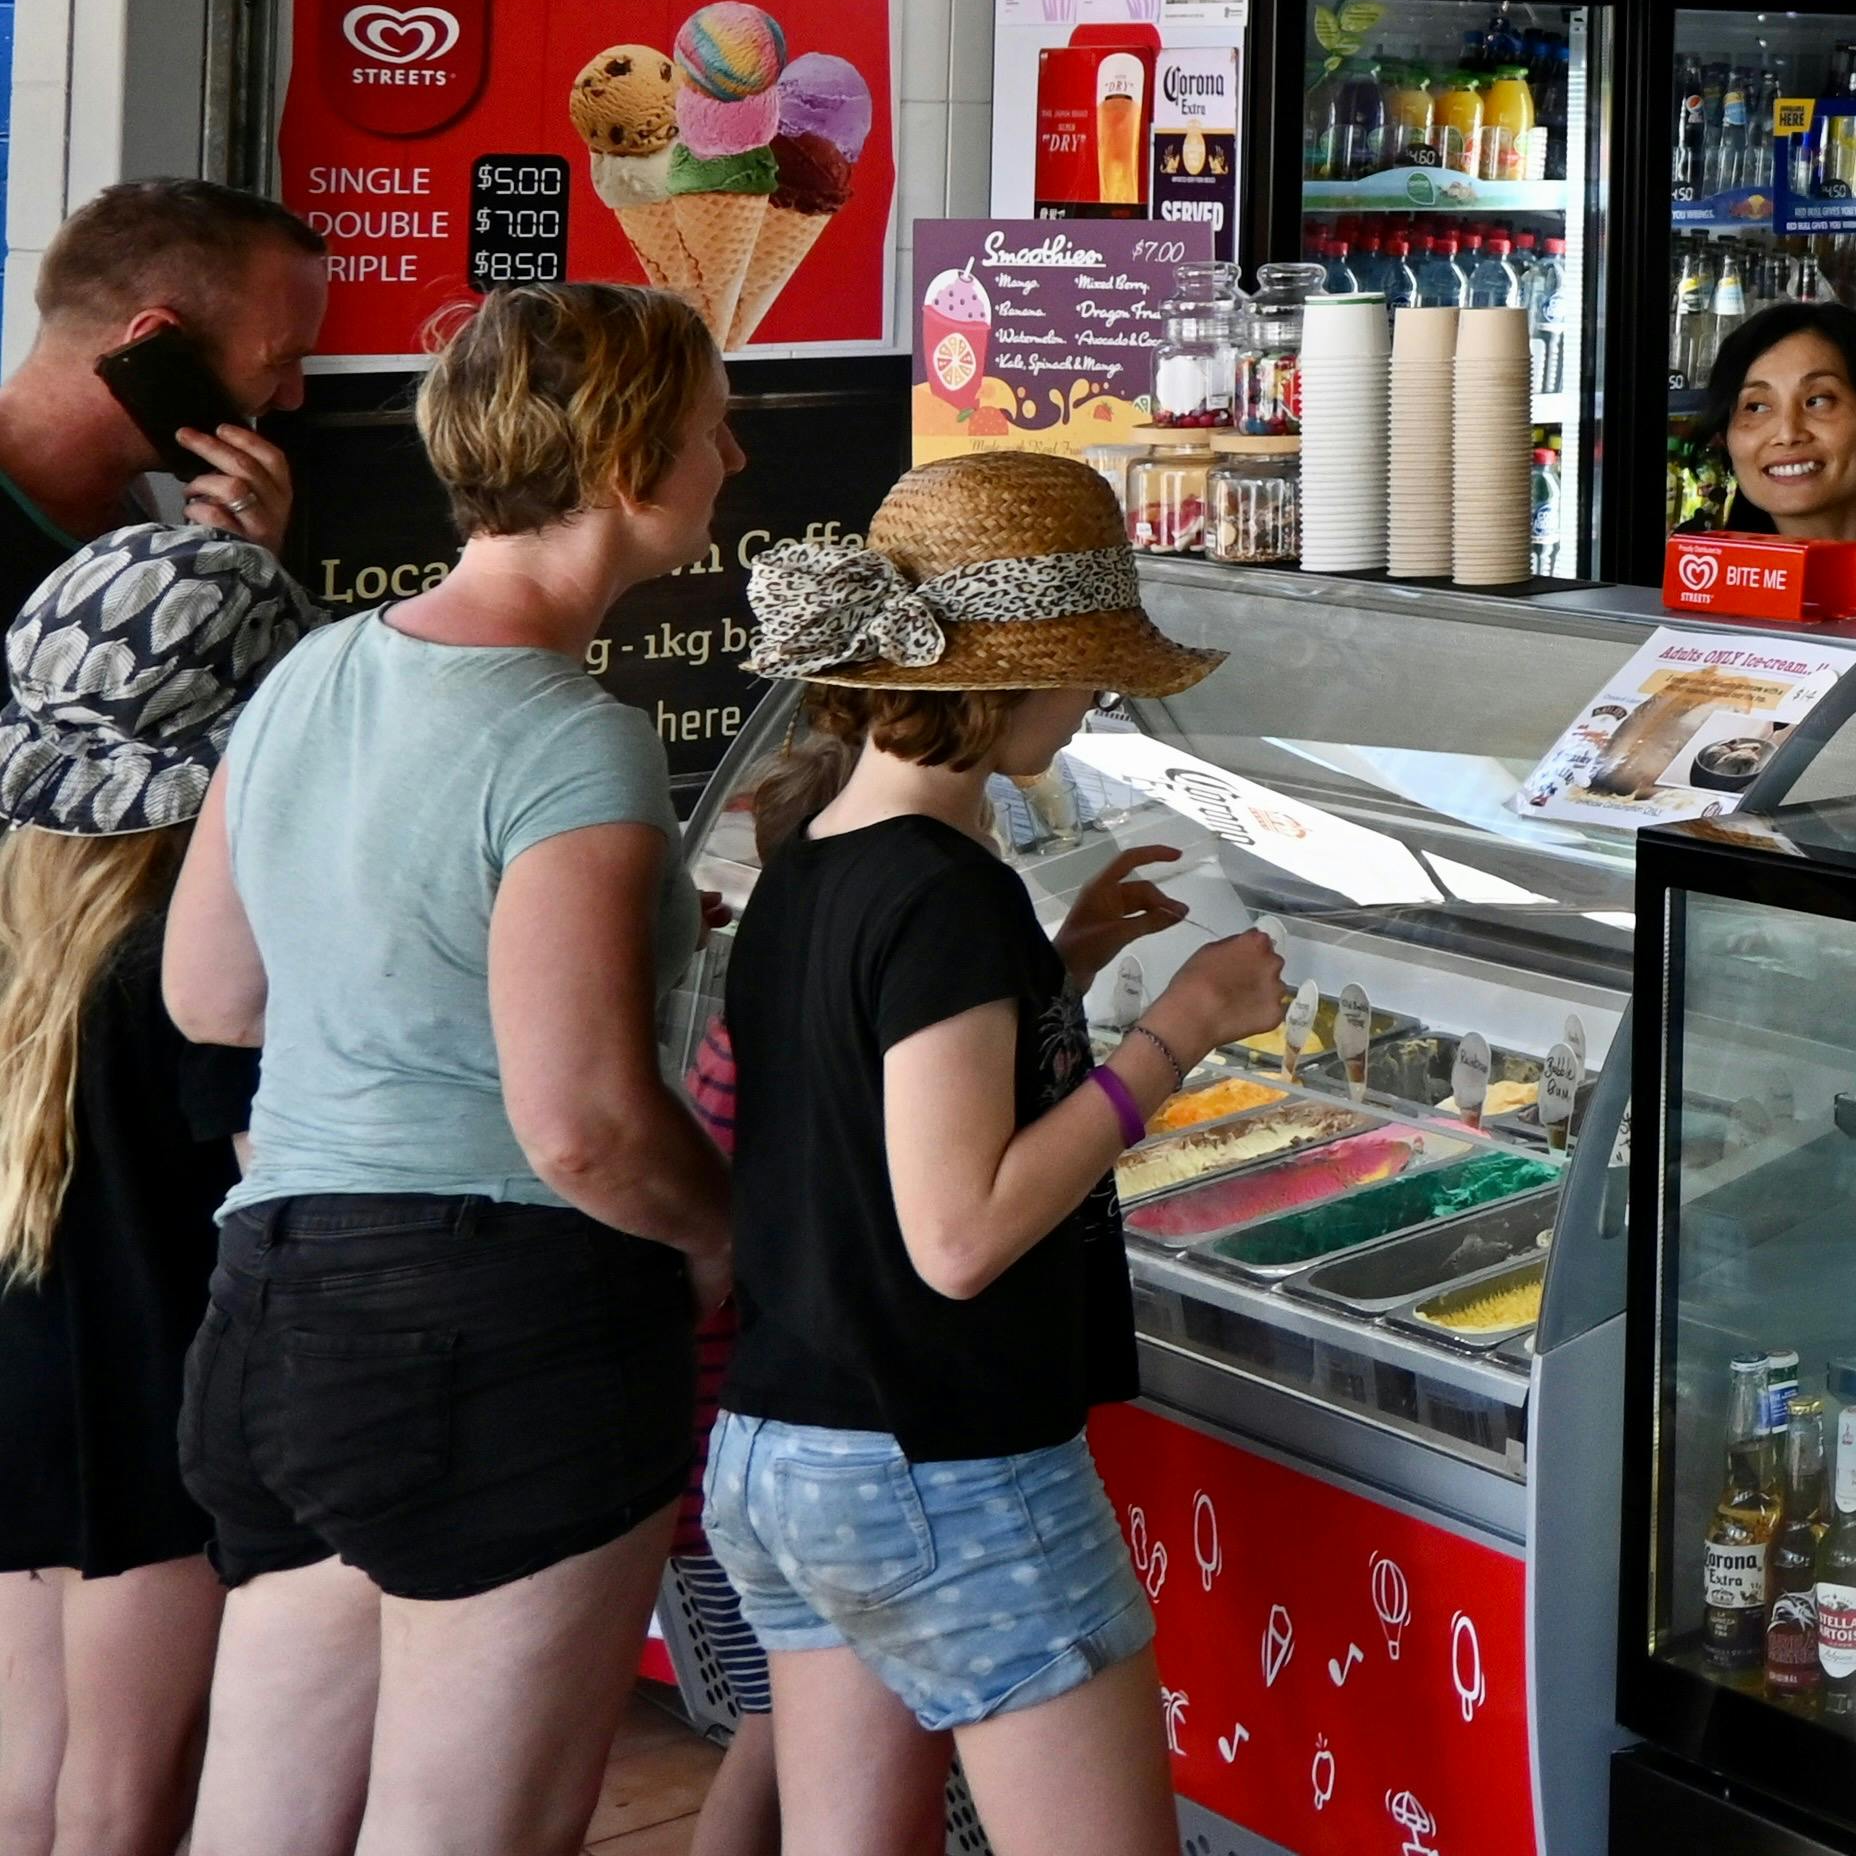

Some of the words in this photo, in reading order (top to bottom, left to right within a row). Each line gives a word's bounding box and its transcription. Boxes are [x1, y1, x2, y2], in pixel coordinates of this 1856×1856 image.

[352, 68, 447, 85] STREETS
[1163, 65, 1224, 105] Corona
[1182, 99, 1205, 115] Extra
[308, 167, 430, 194] SINGLE
[477, 164, 561, 194] $5.00
[308, 211, 449, 238] DOUBLE
[475, 207, 559, 238] $7.00
[1161, 201, 1224, 231] SERVED
[982, 231, 1102, 266] Smoothies
[1132, 240, 1184, 262] $7.00
[322, 255, 417, 282] RIPLE
[474, 250, 558, 280] $8.50
[1078, 276, 1114, 290] Mixed
[1080, 302, 1129, 327] Dragon
[1726, 567, 1760, 587] BITE
[1763, 569, 1787, 590] ME
[1681, 592, 1711, 603] STREETS
[644, 622, 712, 665] 1kg
[1659, 647, 1701, 660] Adults
[1703, 650, 1742, 666] ONLY
[657, 701, 740, 742] here
